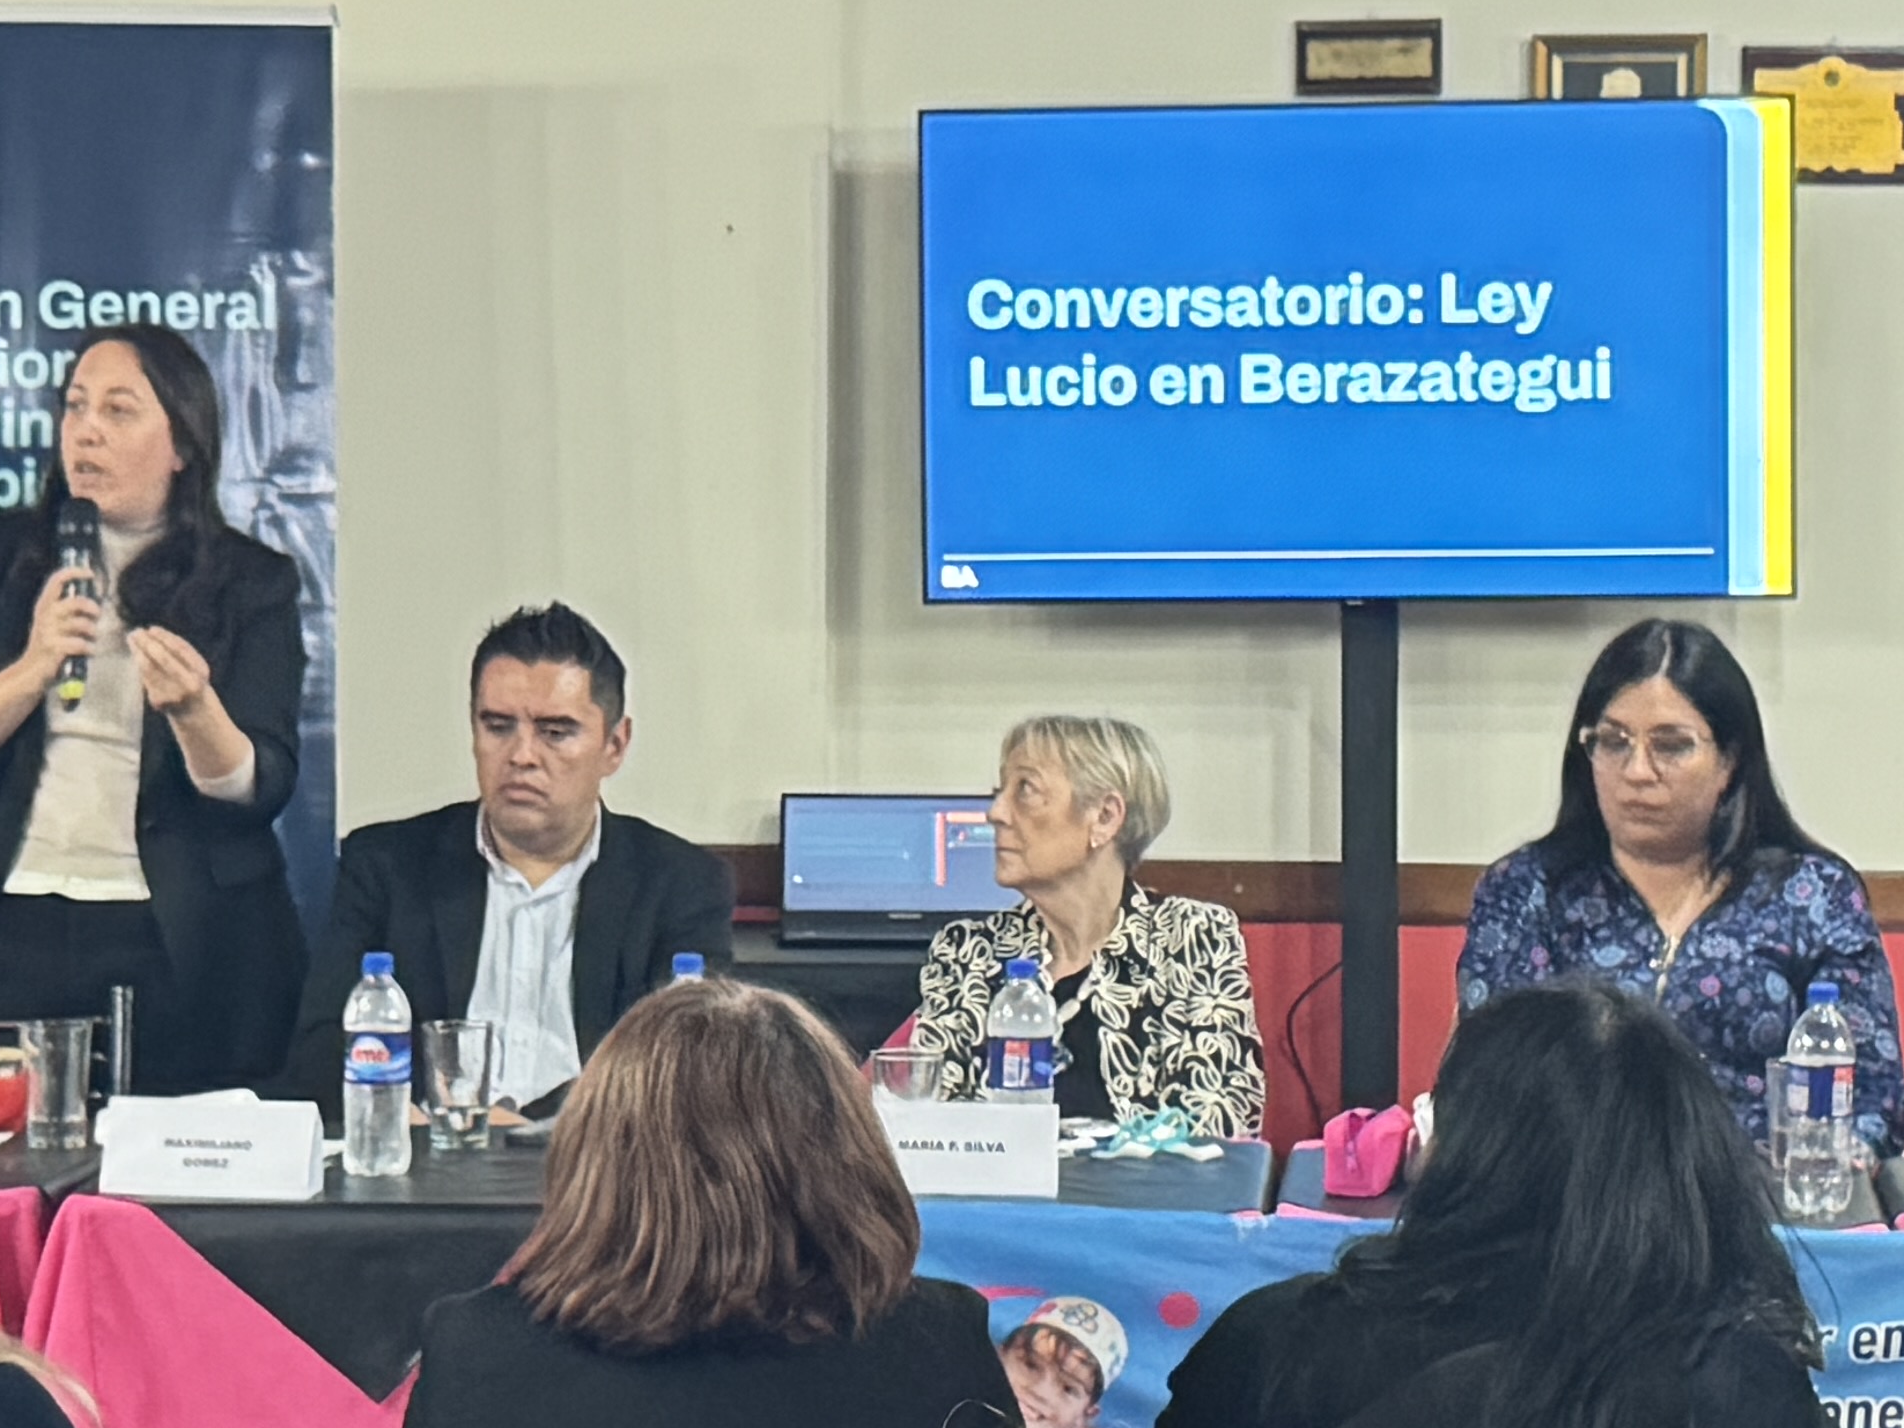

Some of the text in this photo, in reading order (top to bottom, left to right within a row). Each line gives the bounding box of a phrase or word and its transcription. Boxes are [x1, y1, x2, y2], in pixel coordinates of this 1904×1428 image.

[38, 280, 278, 330] General
[967, 274, 1552, 334] Conversatorio: Ley
[969, 347, 1612, 412] Lucio en Berazategui
